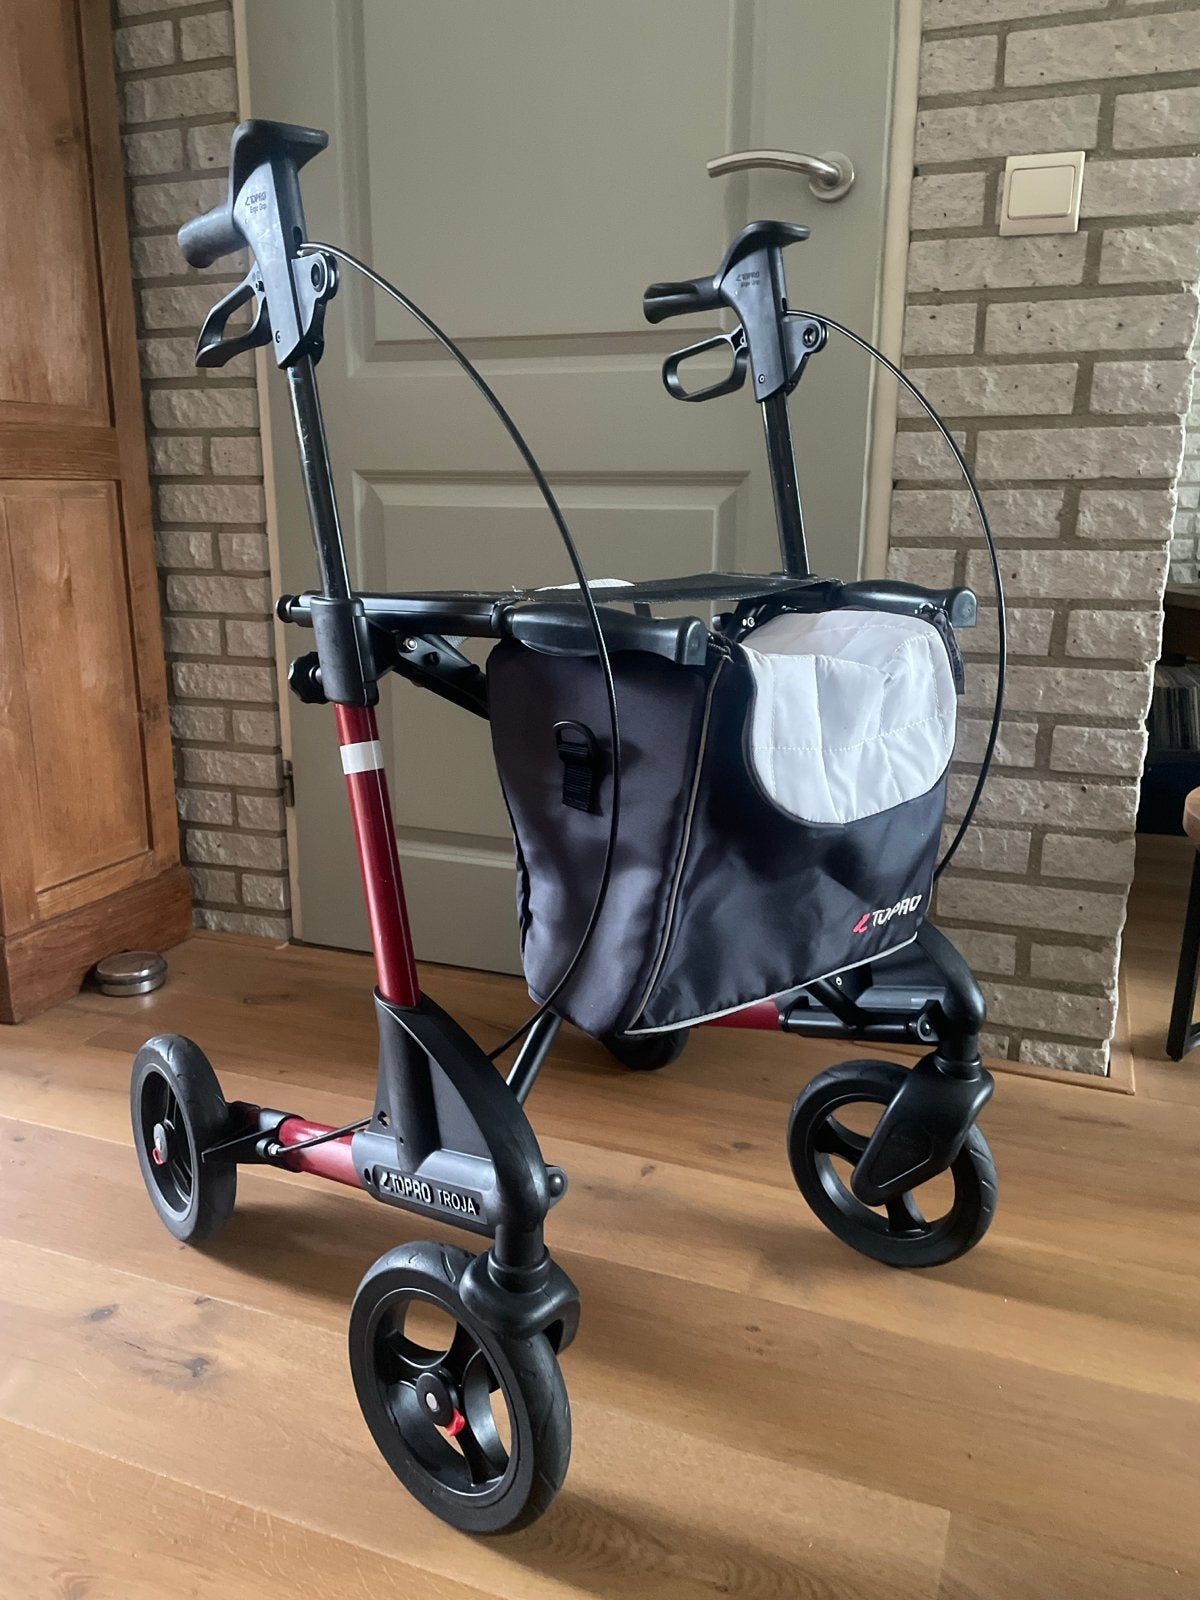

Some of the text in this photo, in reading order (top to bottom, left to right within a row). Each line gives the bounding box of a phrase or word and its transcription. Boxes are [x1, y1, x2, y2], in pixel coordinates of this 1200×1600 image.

[872, 894, 922, 927] TOPRO
[389, 1173, 478, 1216] TOPRO TROJA
